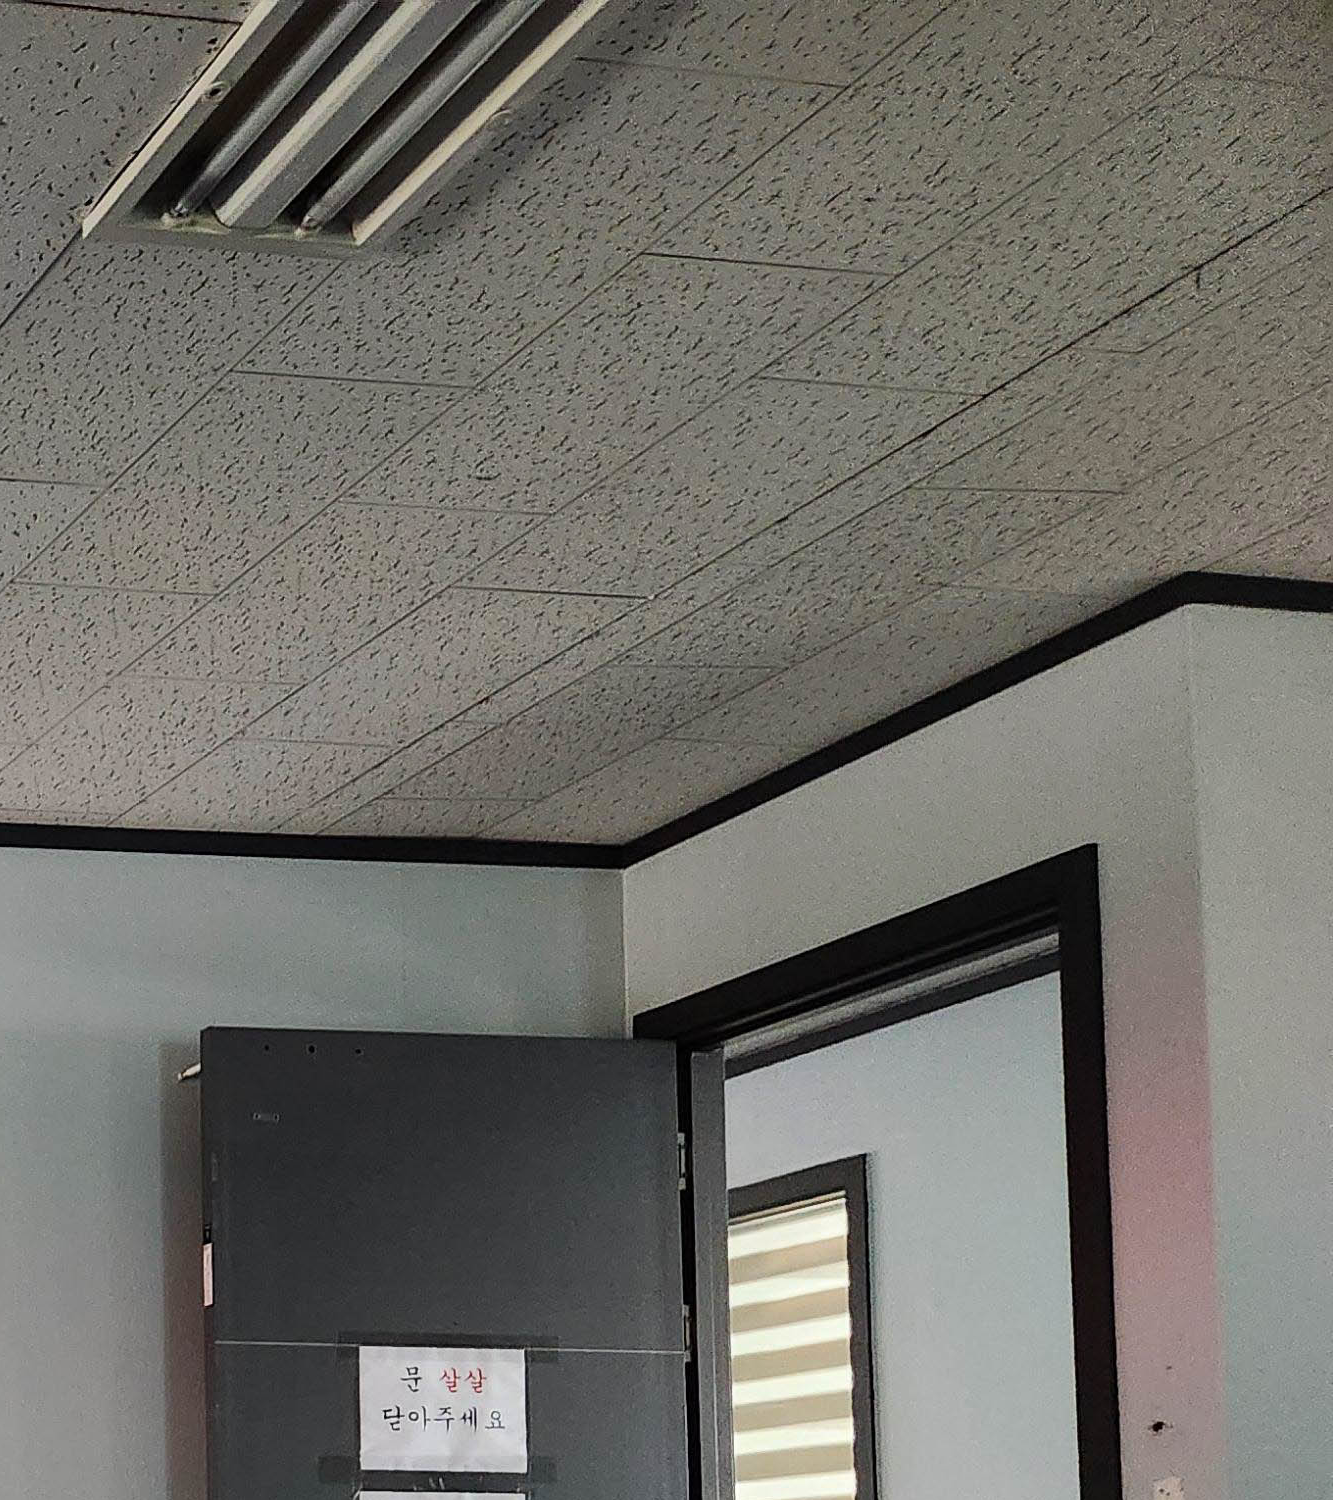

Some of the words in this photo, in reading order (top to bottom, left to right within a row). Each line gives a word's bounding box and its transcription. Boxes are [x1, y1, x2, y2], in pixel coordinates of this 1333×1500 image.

[400, 1366, 423, 1393] 문
[439, 1367, 487, 1393] 살살
[382, 1405, 506, 1432] 닫아주세요
